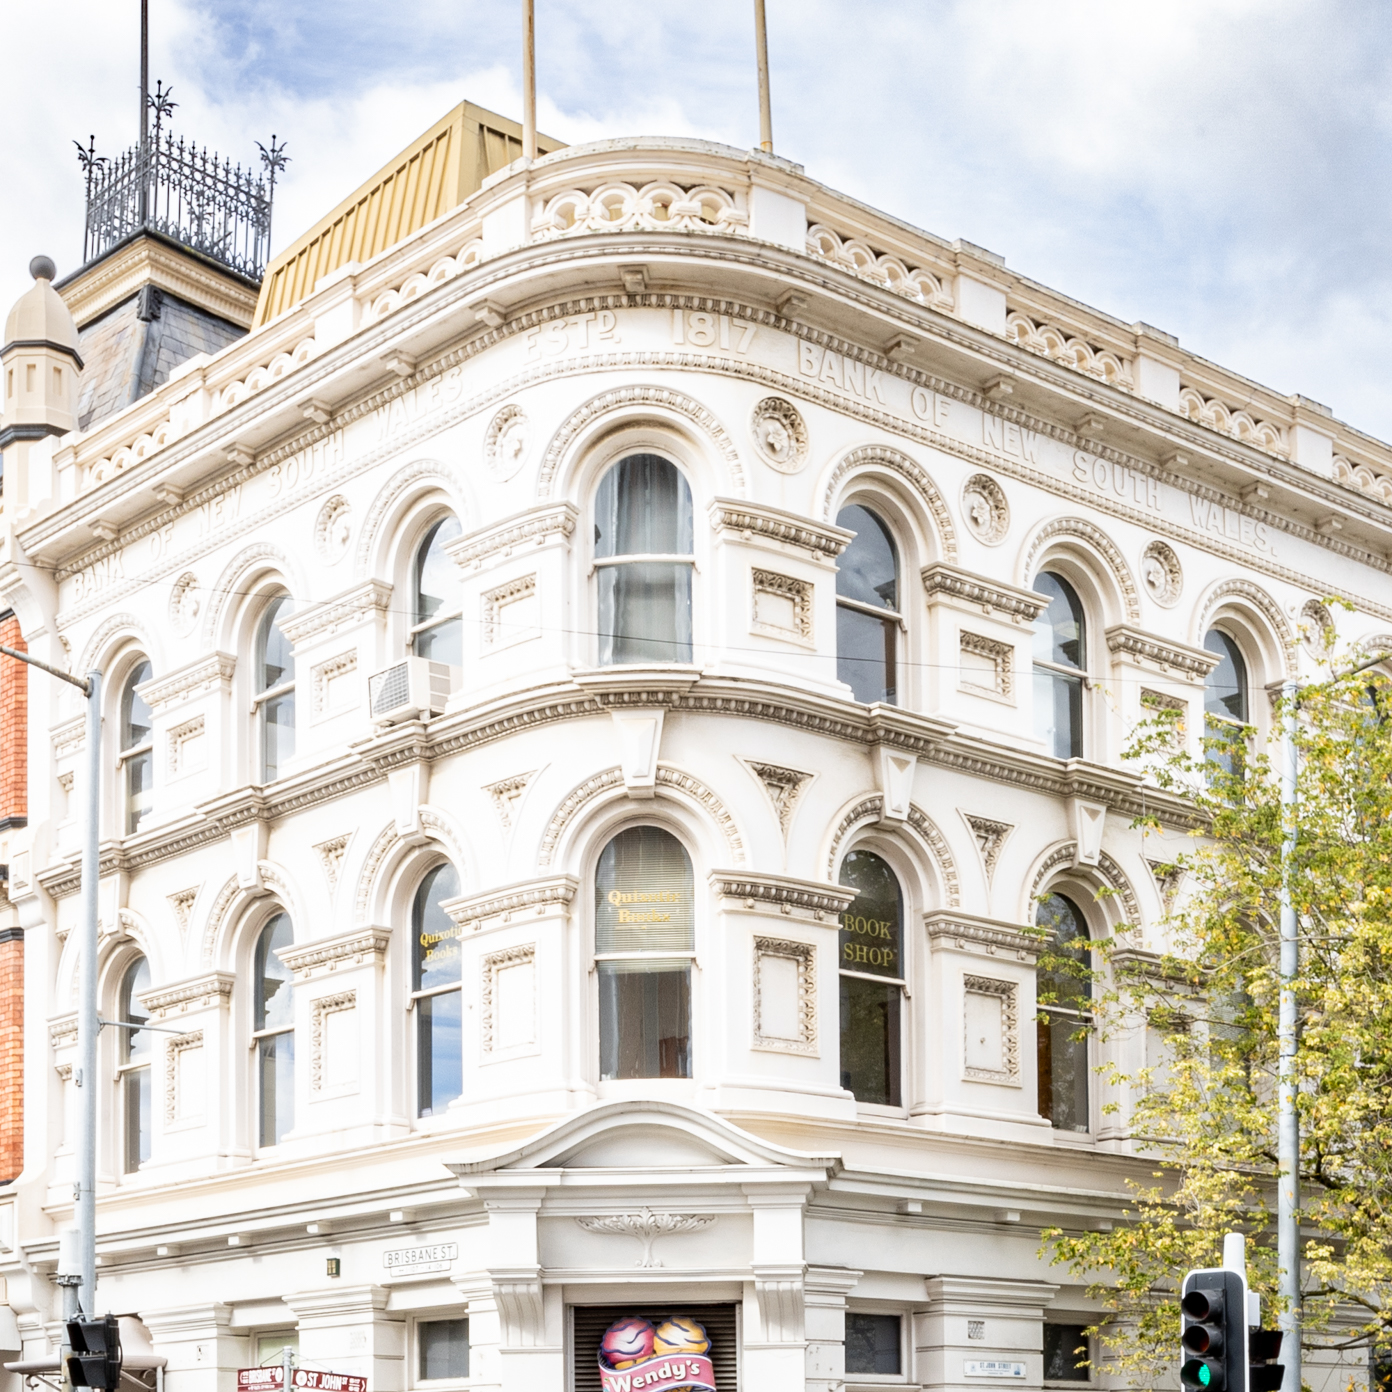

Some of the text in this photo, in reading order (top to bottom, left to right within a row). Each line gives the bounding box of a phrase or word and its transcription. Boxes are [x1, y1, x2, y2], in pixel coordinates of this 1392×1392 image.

[671, 308, 758, 355] 1817
[797, 337, 887, 405] BANK
[910, 385, 950, 429] OF
[981, 410, 1042, 466] NEW
[1072, 449, 1163, 513] SOUTH
[71, 549, 125, 602] BANK
[149, 521, 175, 563] OF
[196, 482, 244, 537] NEW
[268, 431, 347, 499] SOUTH
[618, 908, 671, 923] Books
[843, 913, 893, 940] BOOK
[425, 944, 458, 963] Books
[843, 942, 894, 967] SHOP
[387, 1247, 438, 1266] BRISBANE
[307, 1372, 319, 1387] ST
[319, 1374, 343, 1391] JOHN
